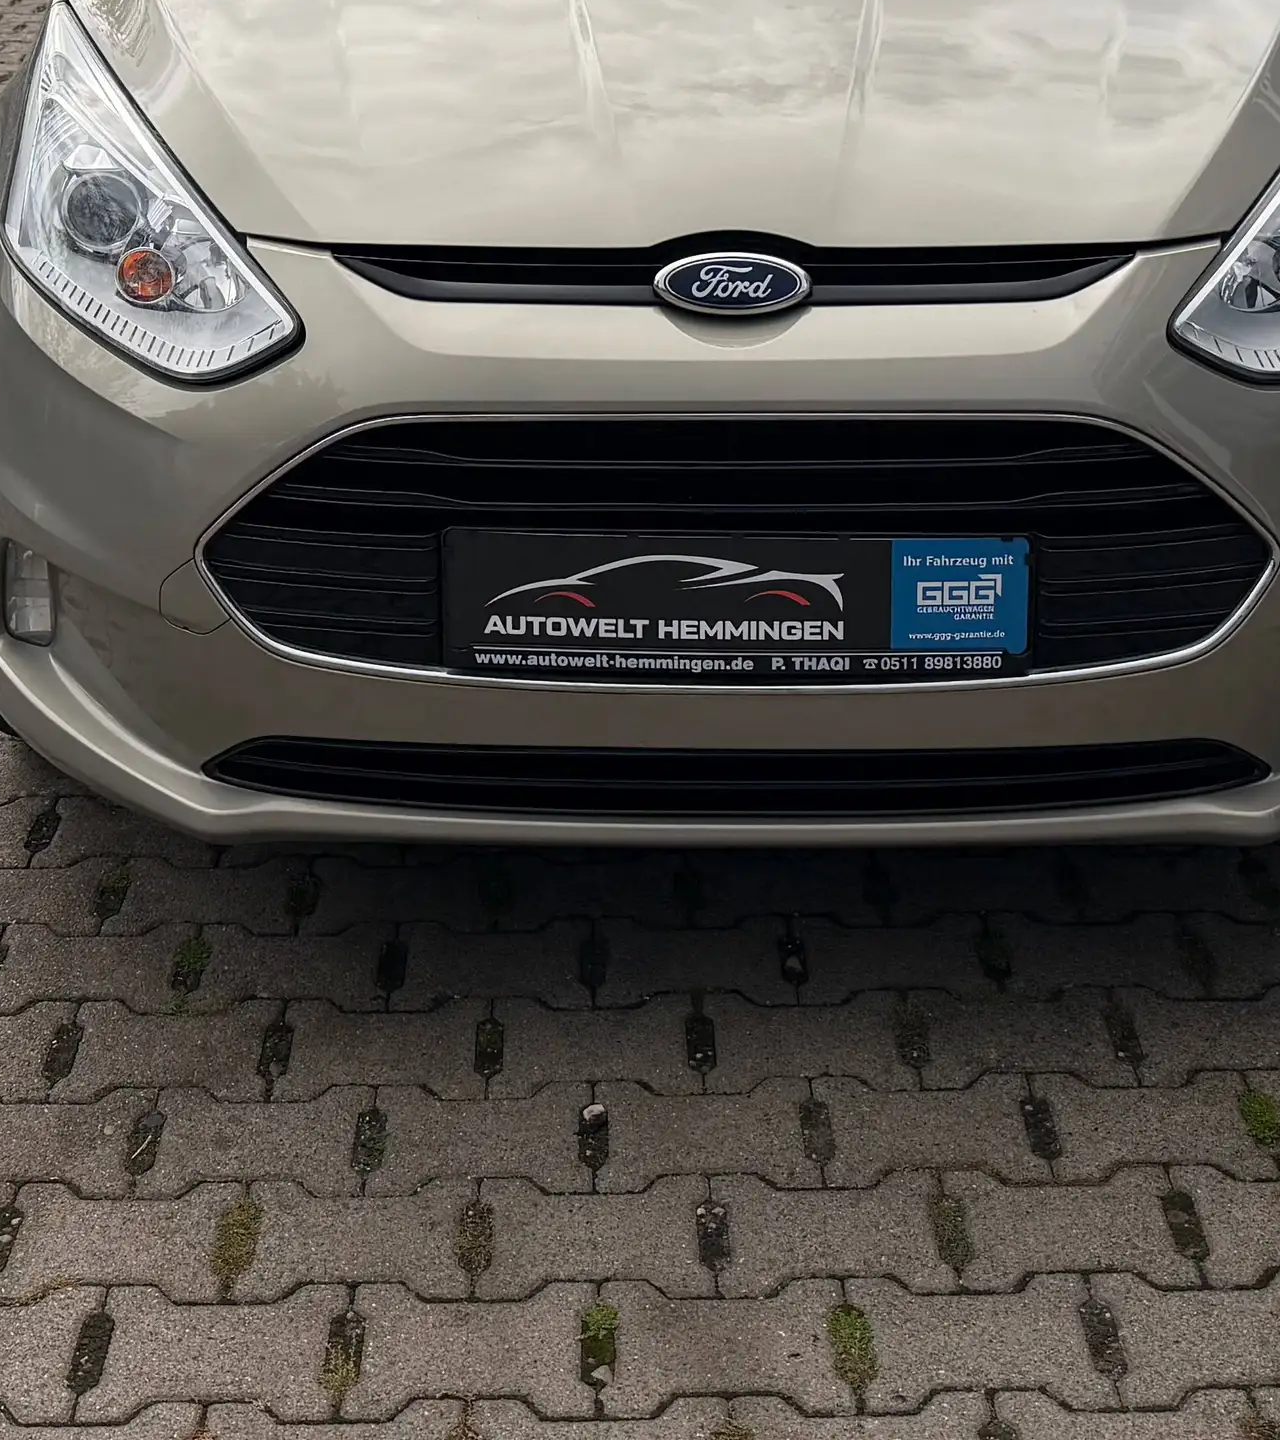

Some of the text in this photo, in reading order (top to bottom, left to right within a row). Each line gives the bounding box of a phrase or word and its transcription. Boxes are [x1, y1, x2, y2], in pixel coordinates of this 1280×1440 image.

[691, 264, 773, 298] Ford
[903, 554, 1014, 568] Ihr Fahrzeug mit
[917, 581, 995, 606] GGG
[917, 605, 995, 614] GEBRAUCHTWAGEN
[953, 613, 994, 621] GARANTIE
[484, 615, 845, 641] AUTOWELT HEMMINGEN
[908, 630, 1006, 641] www.ggg-garantie.de
[474, 651, 1003, 673] www.autowelt-hemmingen.de P. THAQI 0511 89813880
